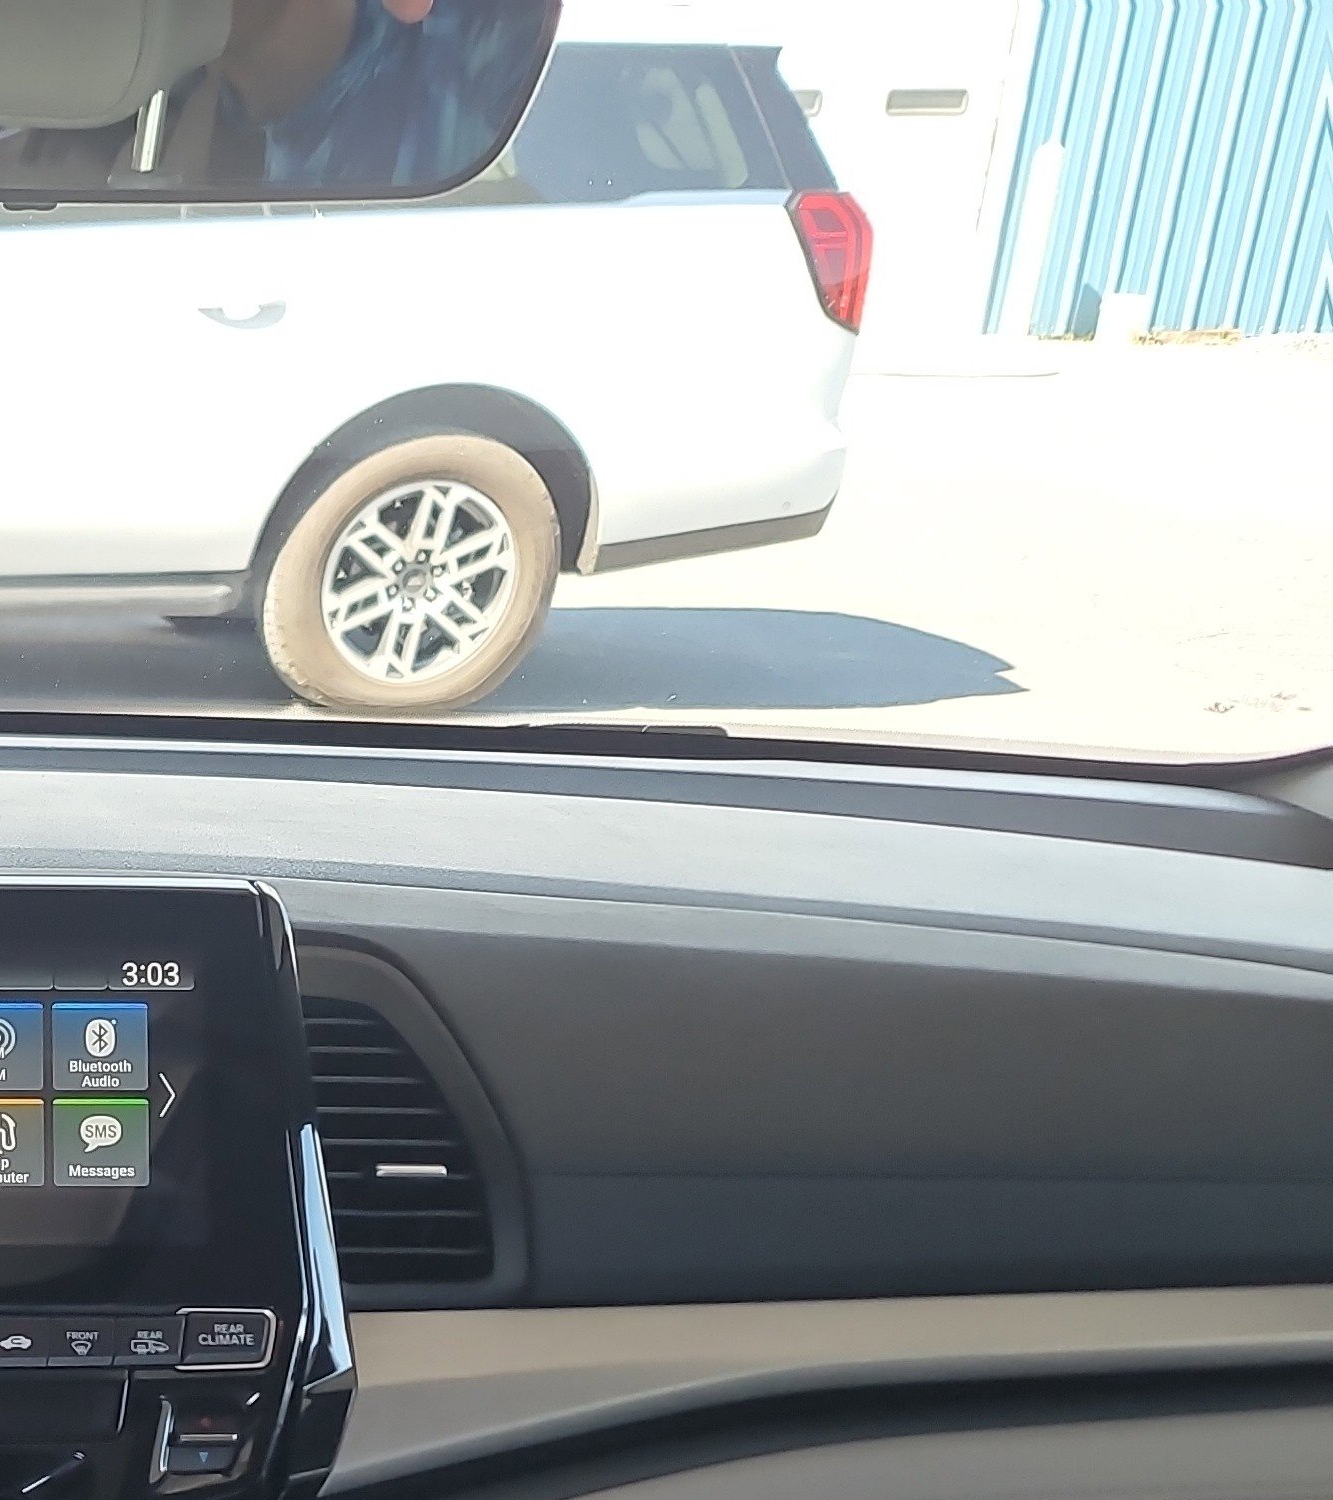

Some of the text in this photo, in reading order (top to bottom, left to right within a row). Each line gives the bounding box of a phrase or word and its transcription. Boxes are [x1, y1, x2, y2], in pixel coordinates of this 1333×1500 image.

[121, 961, 180, 987] 3:03
[69, 1060, 132, 1073] Bluetooth
[82, 1075, 119, 1087] Audio
[84, 1124, 117, 1139] SMS
[68, 1164, 135, 1180] Messages
[214, 1323, 245, 1334] REAR
[66, 1331, 100, 1341] FRONT
[137, 1331, 163, 1340] REAR
[198, 1333, 255, 1346] CLIMATE
